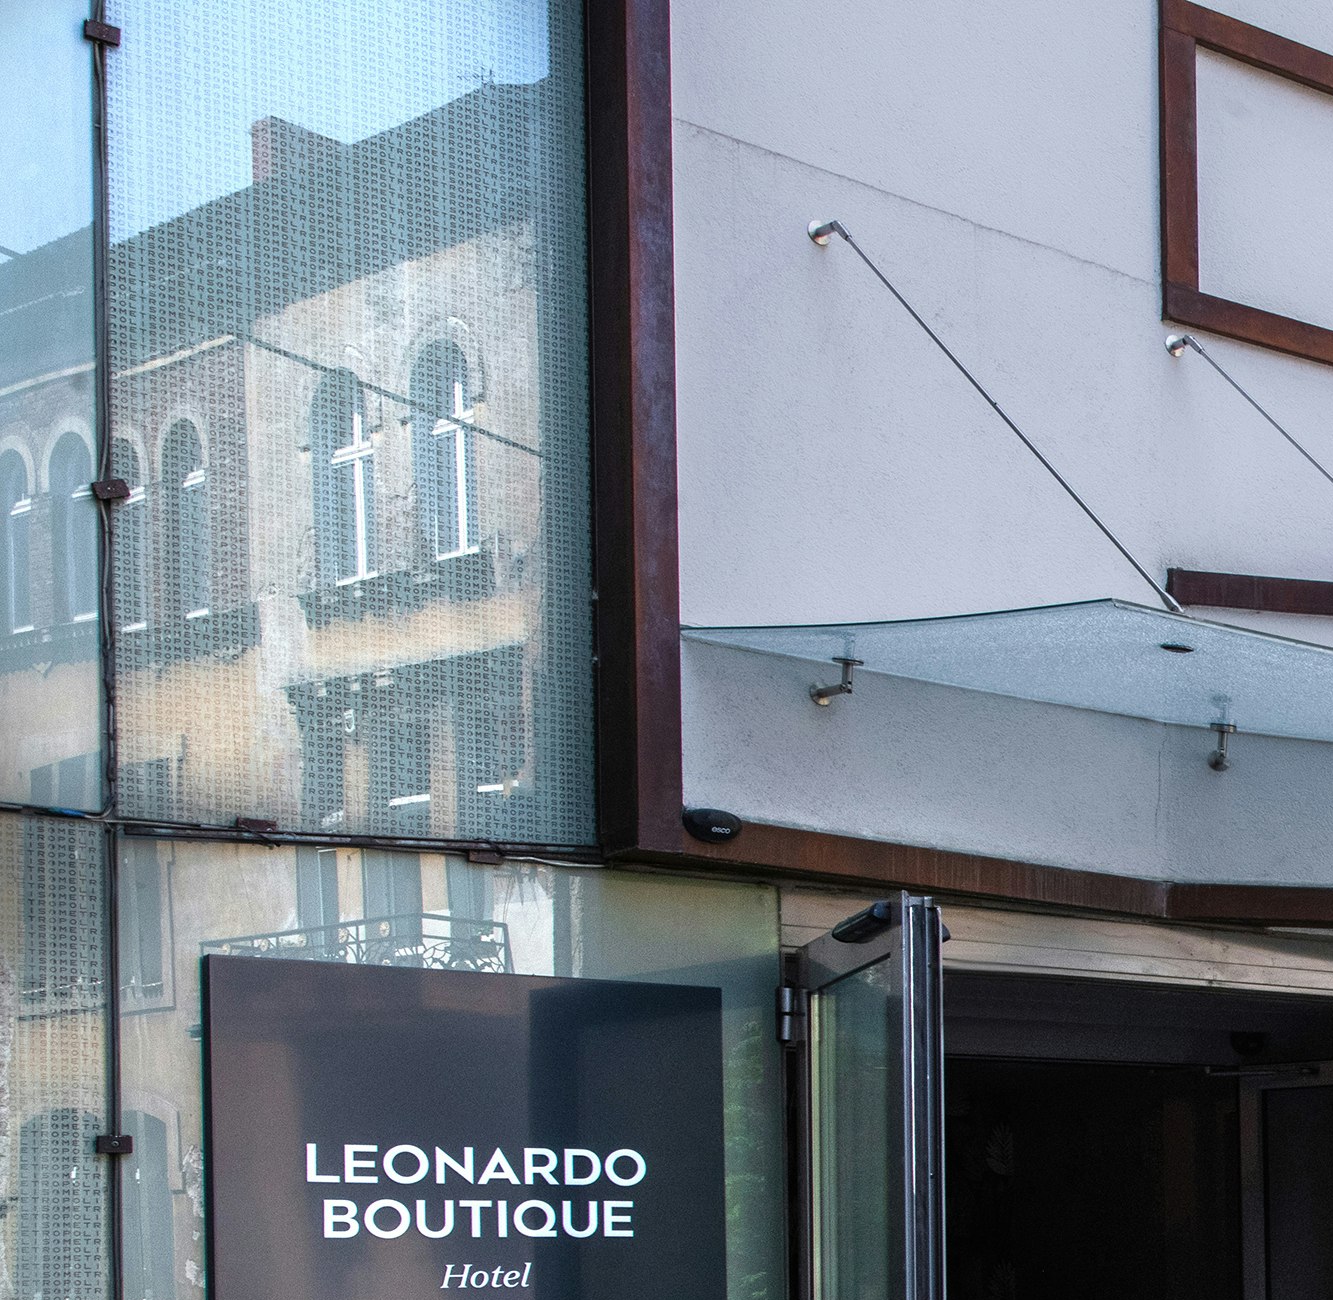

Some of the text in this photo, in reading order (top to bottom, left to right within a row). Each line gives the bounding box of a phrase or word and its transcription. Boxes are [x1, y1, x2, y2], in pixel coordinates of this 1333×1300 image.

[306, 1142, 646, 1187] LEONARDO
[323, 1198, 634, 1239] BOUTIQUE
[440, 1261, 532, 1289] Hotel
